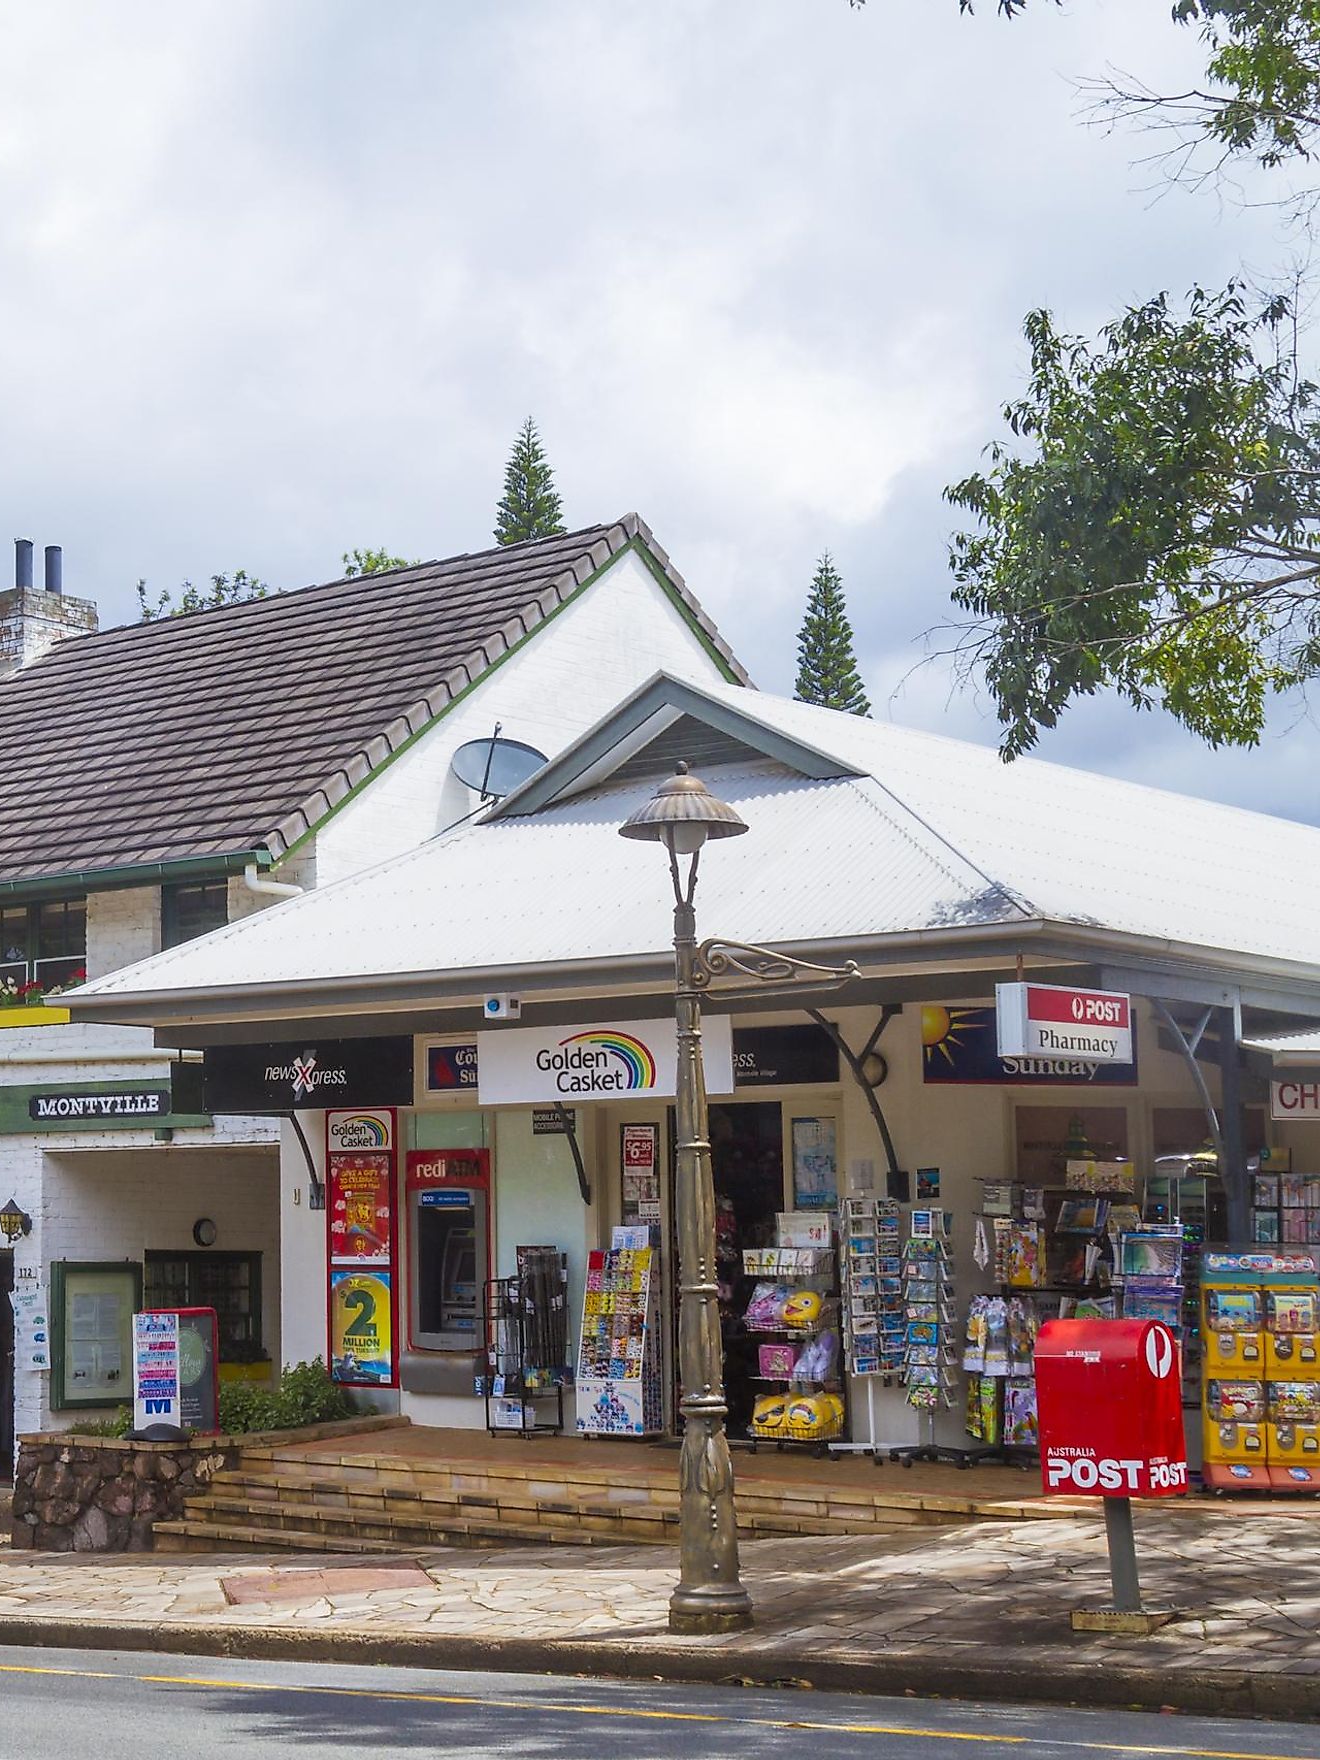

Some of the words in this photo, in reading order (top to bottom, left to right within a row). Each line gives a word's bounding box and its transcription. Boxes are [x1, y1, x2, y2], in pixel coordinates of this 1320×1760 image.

[1086, 1000, 1121, 1022] POST
[1039, 1029, 1118, 1057] Pharmacy
[536, 1047, 608, 1071] Golden
[556, 1070, 623, 1093] Casket
[38, 1095, 159, 1116] MONTVILLE
[1279, 1083, 1320, 1109] CH
[331, 1124, 366, 1136] Golden
[341, 1136, 373, 1147] Casket
[626, 1141, 652, 1158] $6.95
[417, 1160, 446, 1178] redi
[19, 1268, 32, 1277] 172
[343, 1337, 380, 1347] MILLION
[1047, 1447, 1096, 1457] AUSTRALIA
[1047, 1458, 1143, 1489] POST
[1150, 1462, 1187, 1489] POST
